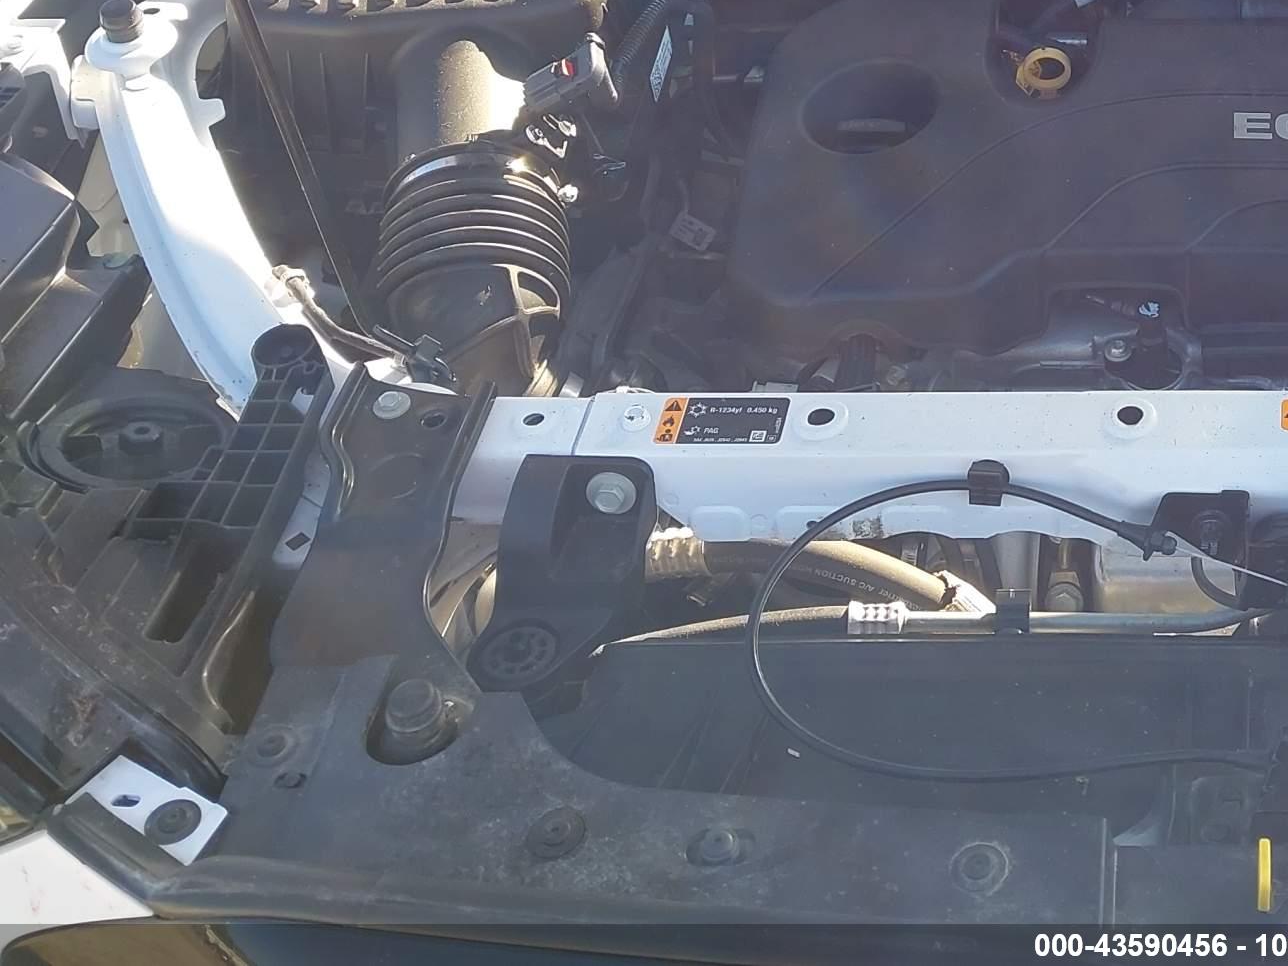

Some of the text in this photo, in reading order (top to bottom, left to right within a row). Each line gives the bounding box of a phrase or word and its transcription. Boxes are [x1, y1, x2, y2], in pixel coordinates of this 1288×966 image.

[767, 406, 778, 415] kg
[703, 427, 720, 435] PAG
[815, 568, 857, 587] SUCTION
